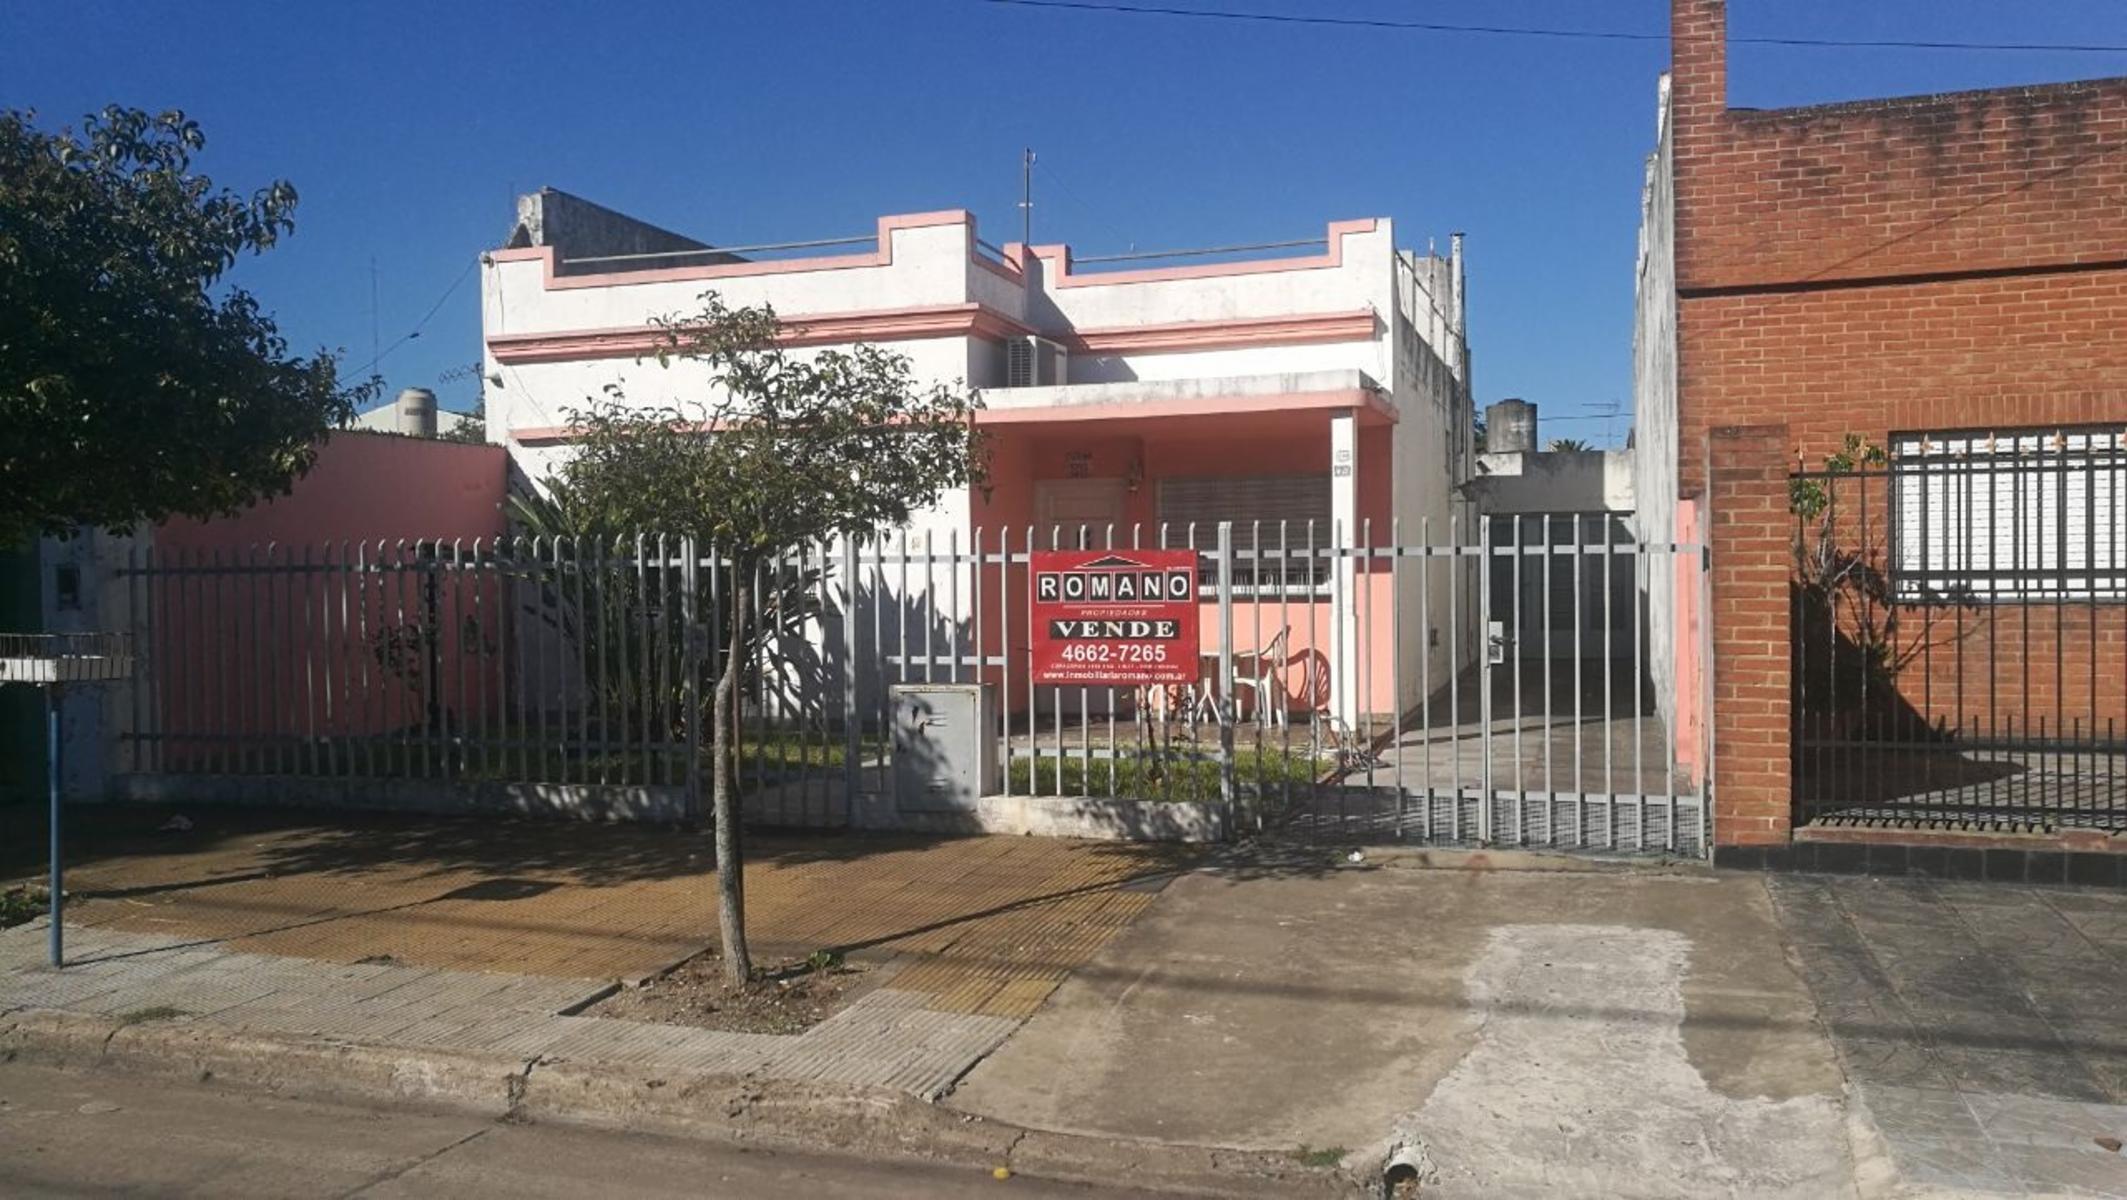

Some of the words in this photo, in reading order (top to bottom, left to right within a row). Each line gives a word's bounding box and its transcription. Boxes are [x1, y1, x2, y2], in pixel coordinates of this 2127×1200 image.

[1041, 575, 1188, 597] ROMANO
[1055, 621, 1175, 638] VENDE
[1061, 644, 1167, 662] 4662-7265
[1043, 670, 1186, 681] www.inmobiliariaromanocom.ar
